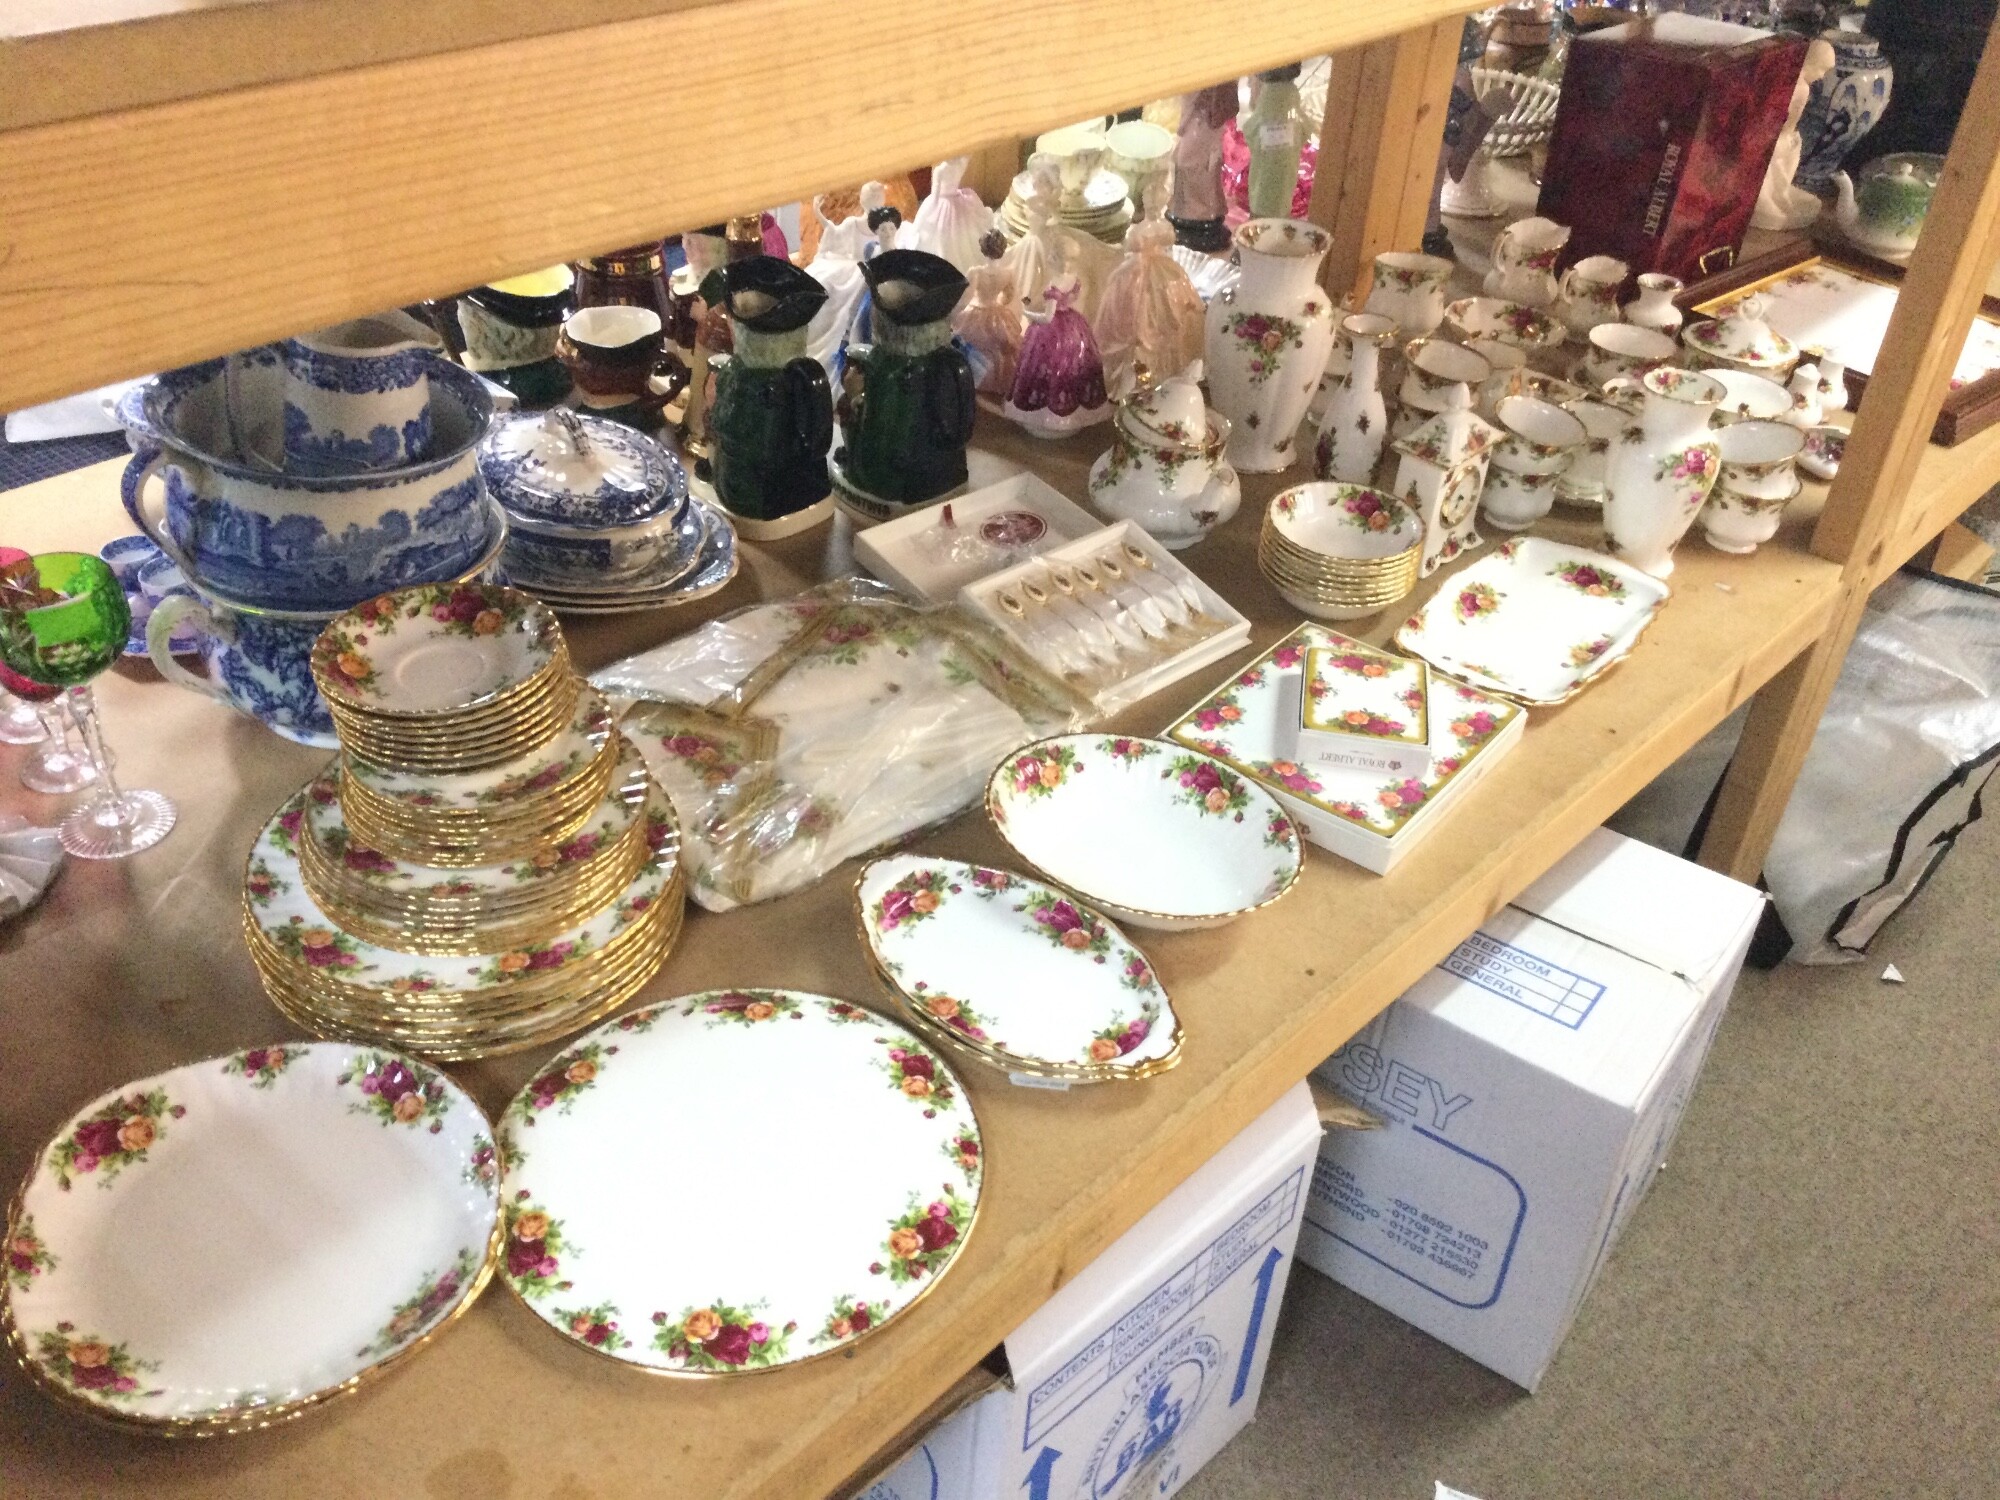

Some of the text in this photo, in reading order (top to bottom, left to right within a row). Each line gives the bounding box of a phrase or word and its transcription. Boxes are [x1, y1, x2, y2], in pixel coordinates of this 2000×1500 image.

[1657, 142, 1682, 184] ROYAL
[1319, 751, 1353, 765] ALBERT
[1358, 757, 1386, 769] ROYAL
[1460, 948, 1514, 975] STUDY
[1470, 935, 1551, 977] BEDROOM
[1451, 960, 1524, 999] GENERAL
[1330, 1043, 1474, 1131] SEY
[1117, 1284, 1170, 1336] KITCHEN
[1035, 1337, 1104, 1403] CONTENTS
